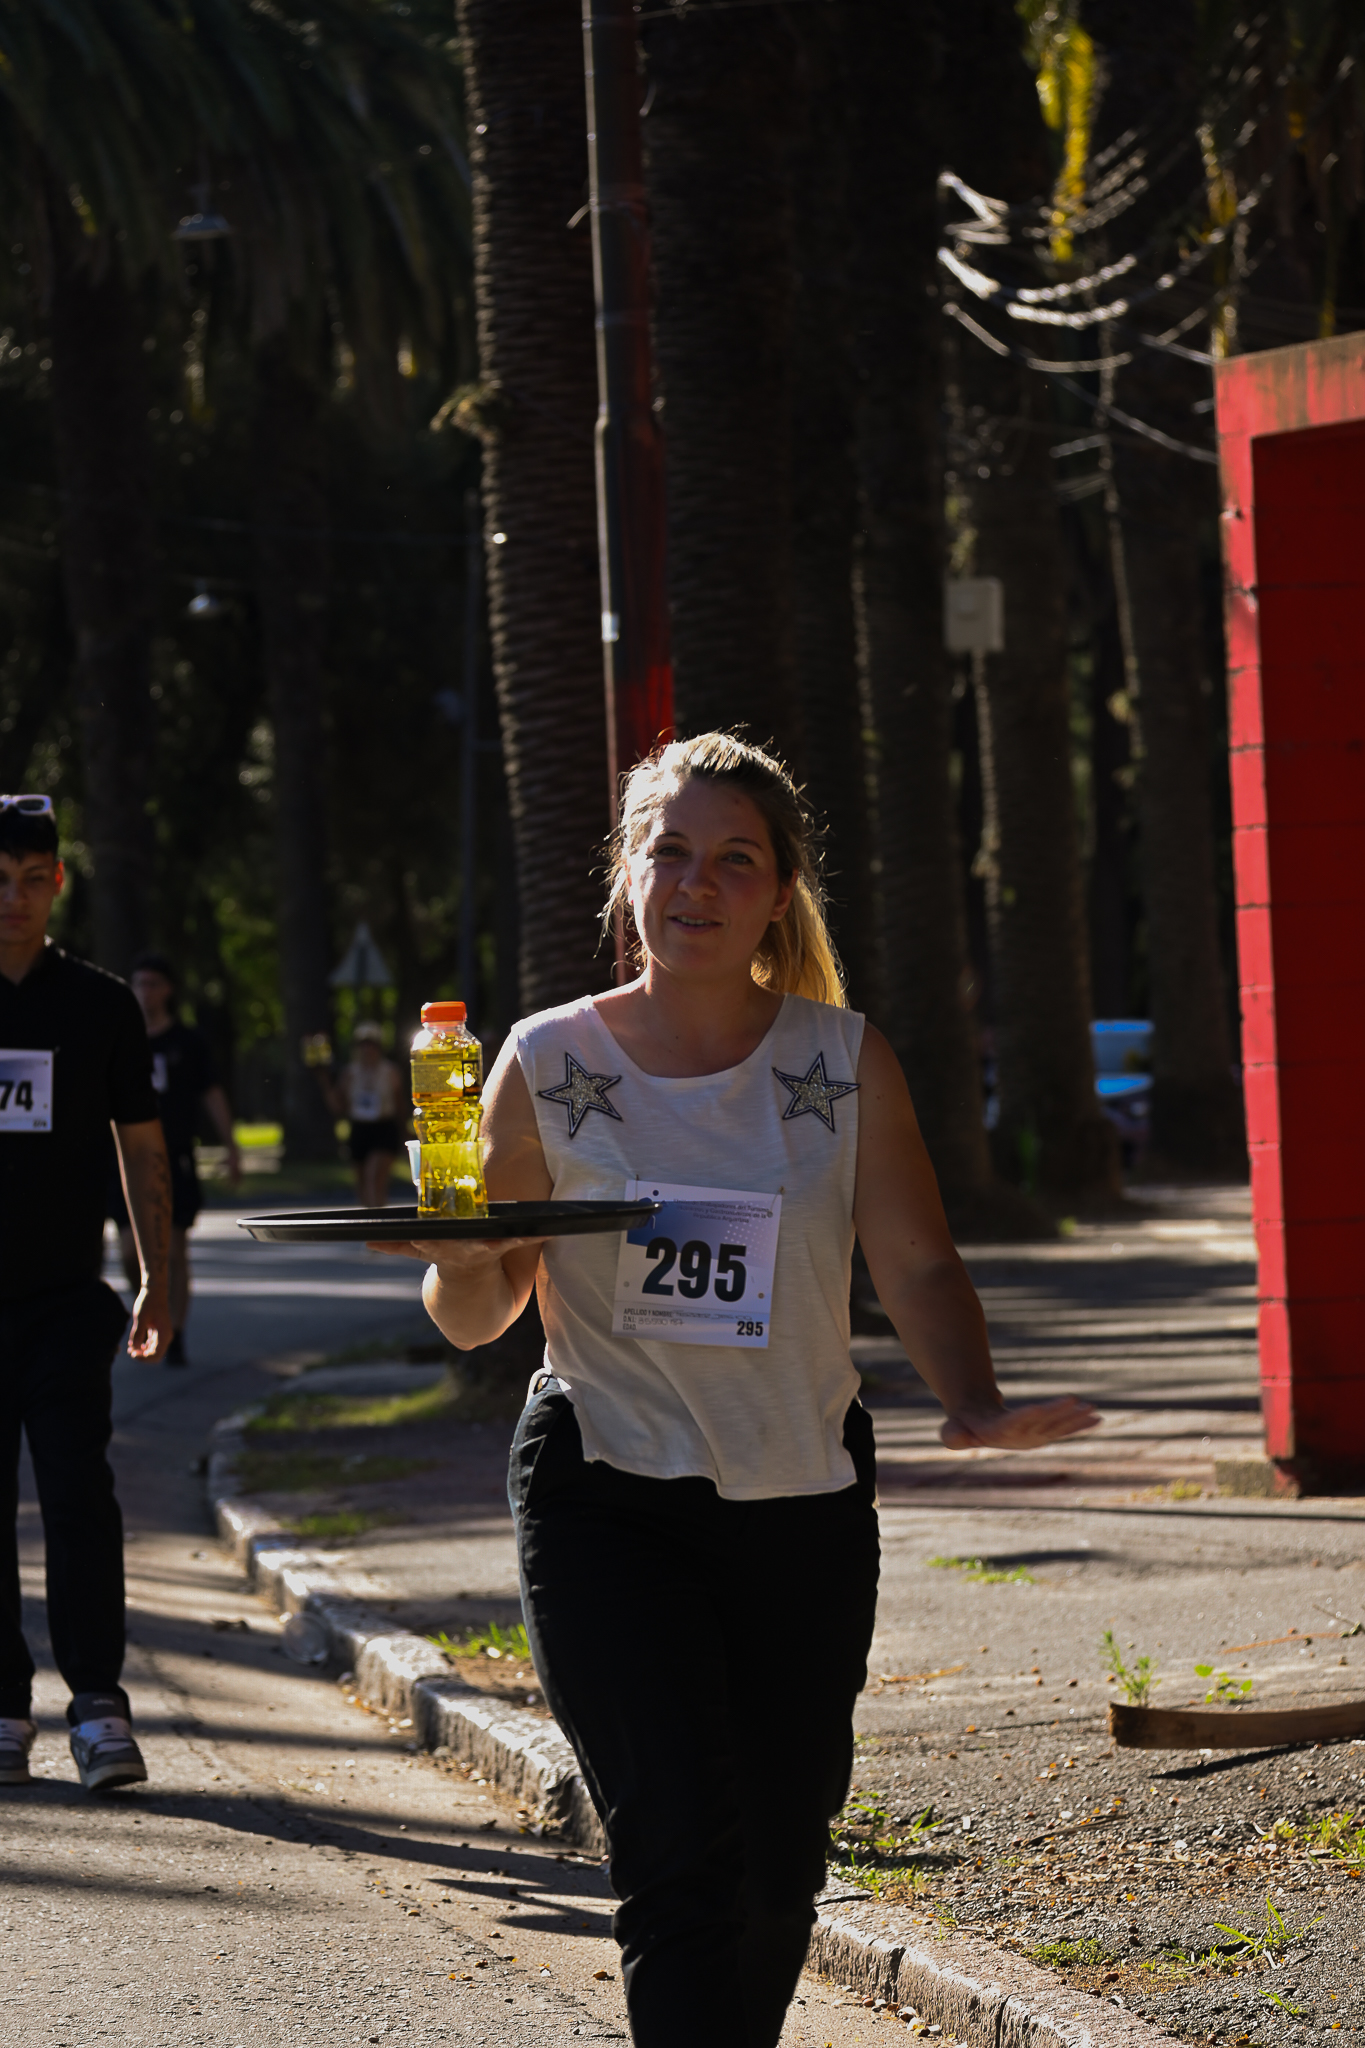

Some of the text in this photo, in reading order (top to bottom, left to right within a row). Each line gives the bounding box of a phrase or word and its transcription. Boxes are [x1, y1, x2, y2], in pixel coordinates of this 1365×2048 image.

[642, 1237, 746, 1302] 295
[623, 1308, 647, 1316] APELLIDO
[737, 1321, 763, 1336] 295
